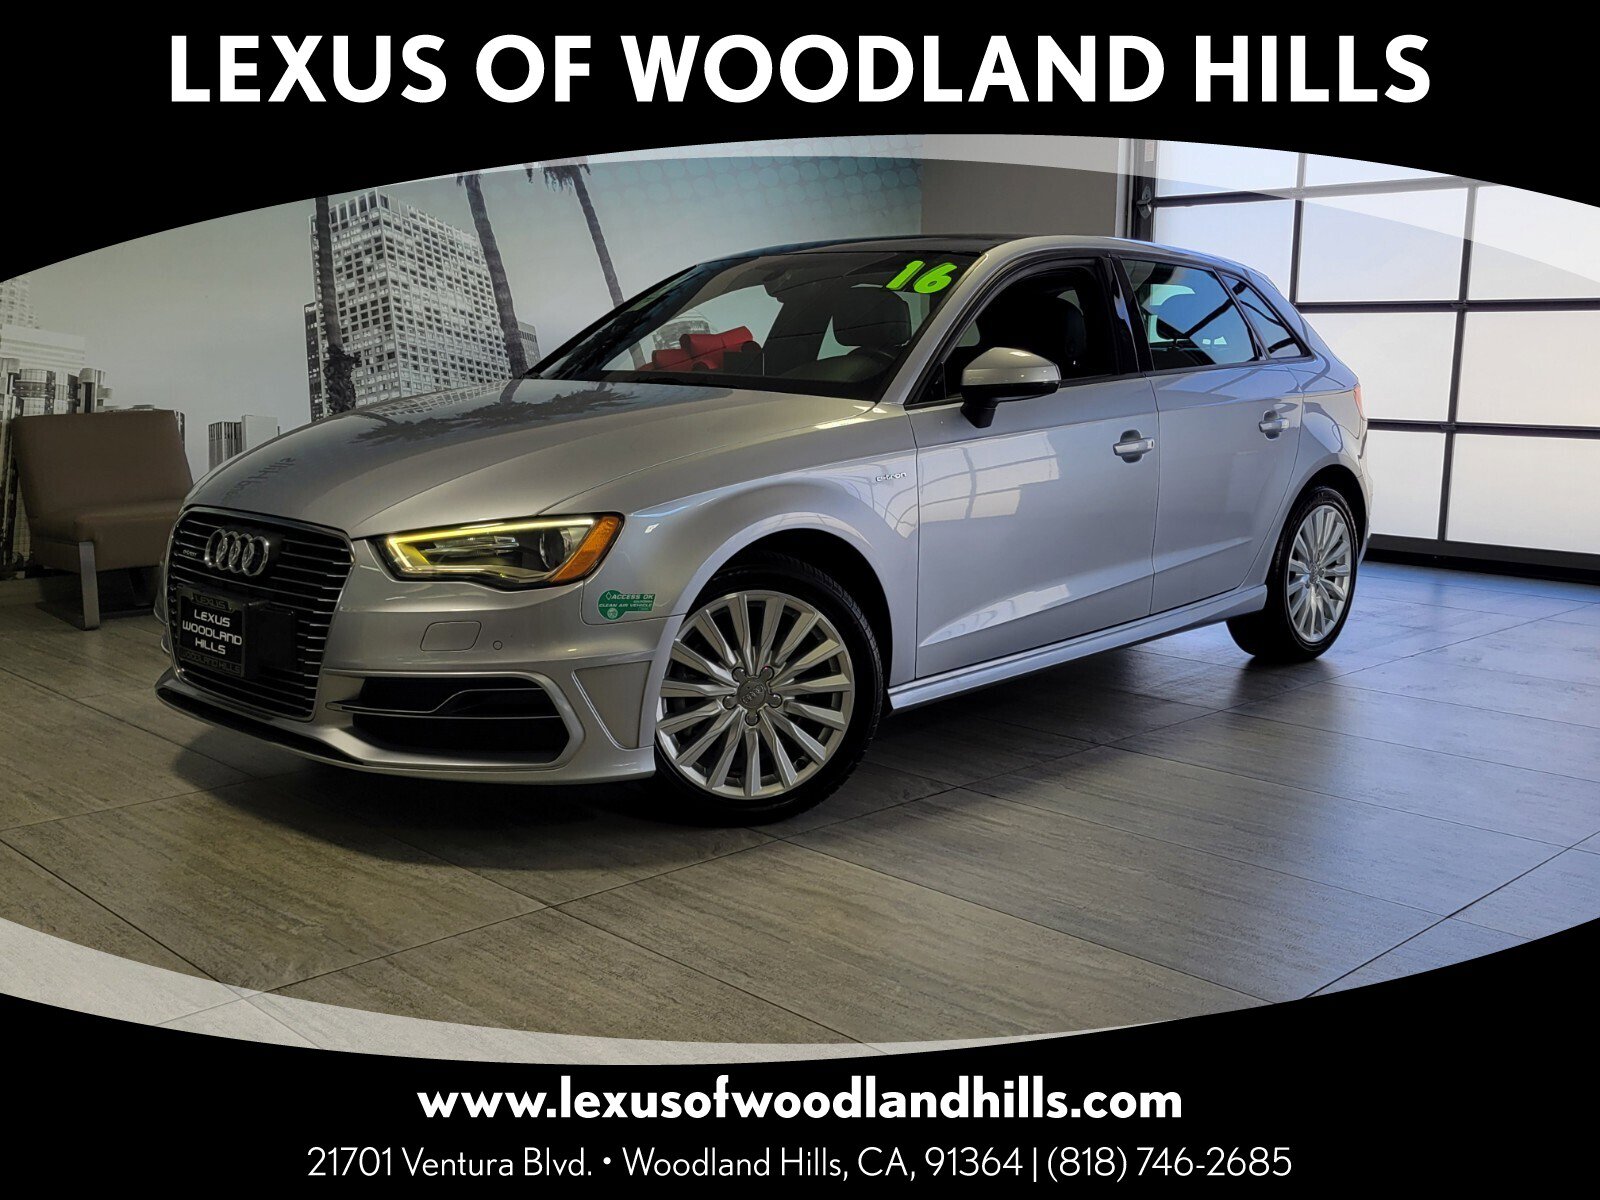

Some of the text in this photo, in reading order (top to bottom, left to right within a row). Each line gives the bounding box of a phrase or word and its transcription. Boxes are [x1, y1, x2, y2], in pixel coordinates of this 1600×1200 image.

[885, 260, 957, 294] 16
[193, 609, 231, 628] LEXUS
[182, 620, 243, 646] WOODLAND
[194, 637, 226, 655] HILLS
